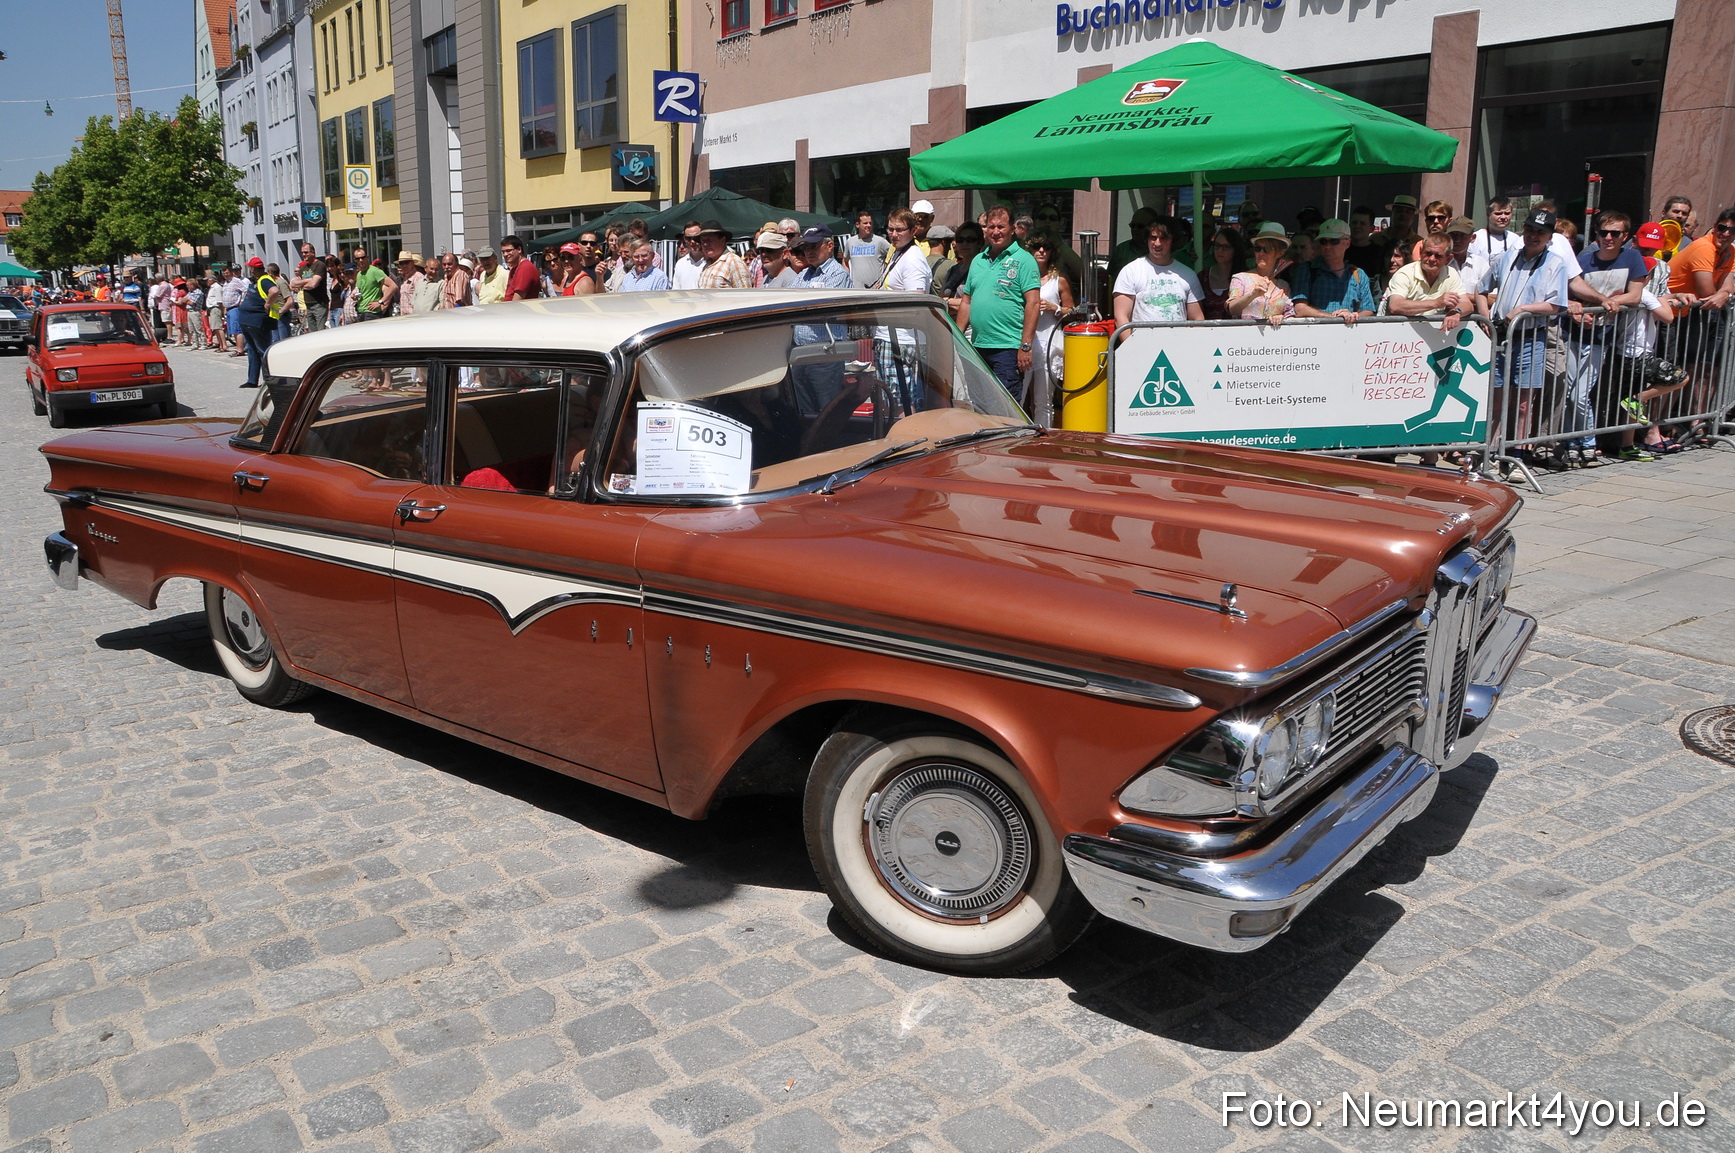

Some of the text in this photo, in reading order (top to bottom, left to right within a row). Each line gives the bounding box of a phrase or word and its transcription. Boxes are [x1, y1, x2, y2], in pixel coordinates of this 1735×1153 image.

[1068, 106, 1200, 123] Neumarkter
[1033, 114, 1213, 139] Lammsbräu
[719, 134, 732, 145] Markt
[732, 132, 738, 142] 15
[1227, 346, 1318, 357] Gebäudereinigung
[1392, 340, 1424, 354] UNS
[1227, 362, 1321, 373] Hausmeisterdienste
[1226, 379, 1281, 390] Mietservice
[1235, 395, 1327, 406] Event-Leit-Systeme
[687, 424, 727, 447] 503
